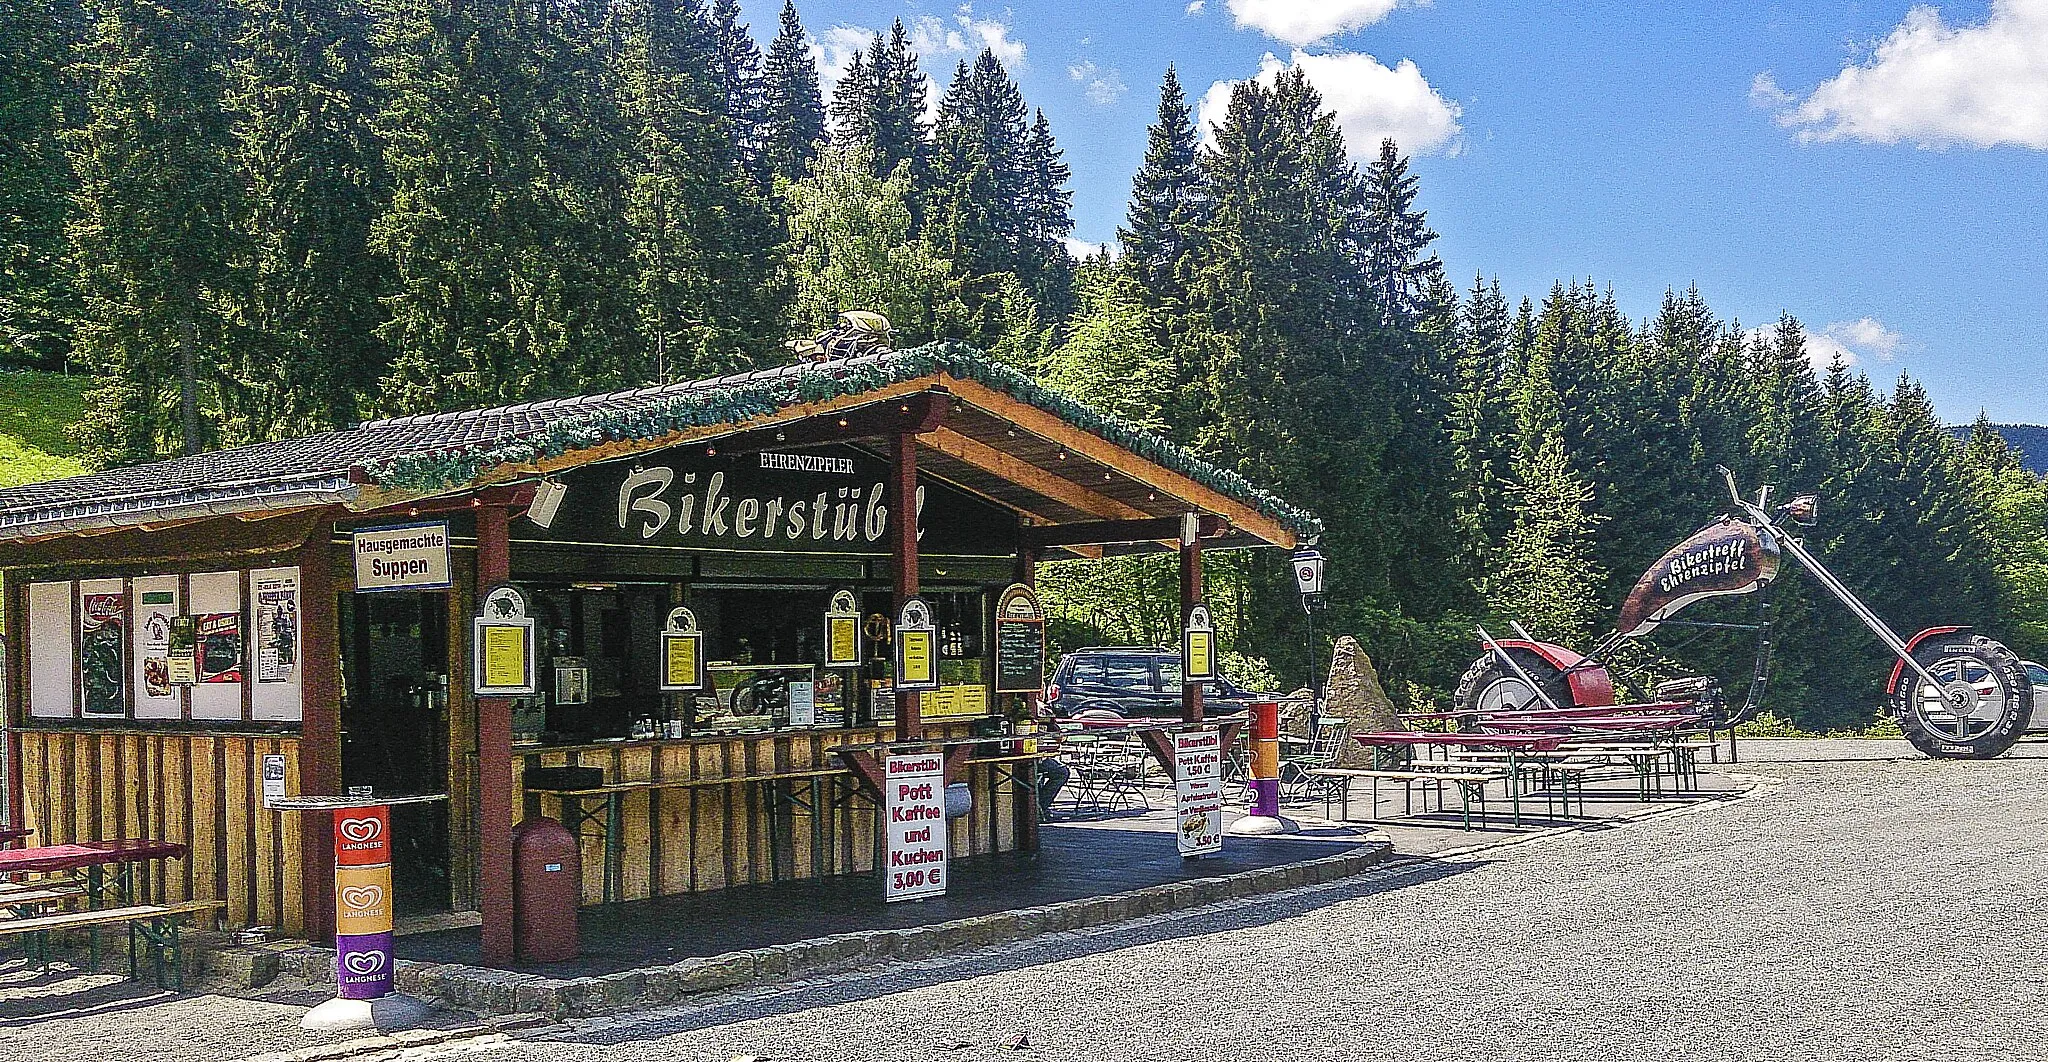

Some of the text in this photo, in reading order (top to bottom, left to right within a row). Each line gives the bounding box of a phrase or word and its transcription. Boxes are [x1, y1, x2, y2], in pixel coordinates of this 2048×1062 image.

[759, 452, 855, 474] EHRENZIPFLER
[358, 533, 444, 554] Hausgemachte
[1669, 539, 1746, 575] Bikertreff
[372, 558, 428, 579] Suppen
[1660, 556, 1746, 592] Ehrenzipfel
[889, 758, 941, 774] Bikerstübl
[1179, 754, 1217, 766] Pott Kaffee
[899, 783, 932, 801] Pott
[892, 805, 940, 822] Kaffee
[905, 826, 931, 843] und
[342, 841, 383, 850] LANGNESE
[892, 849, 943, 867] Kuchen
[894, 869, 941, 890] 3,00 €
[343, 908, 384, 918] LANGNESE
[345, 973, 386, 983] LANGNESE
